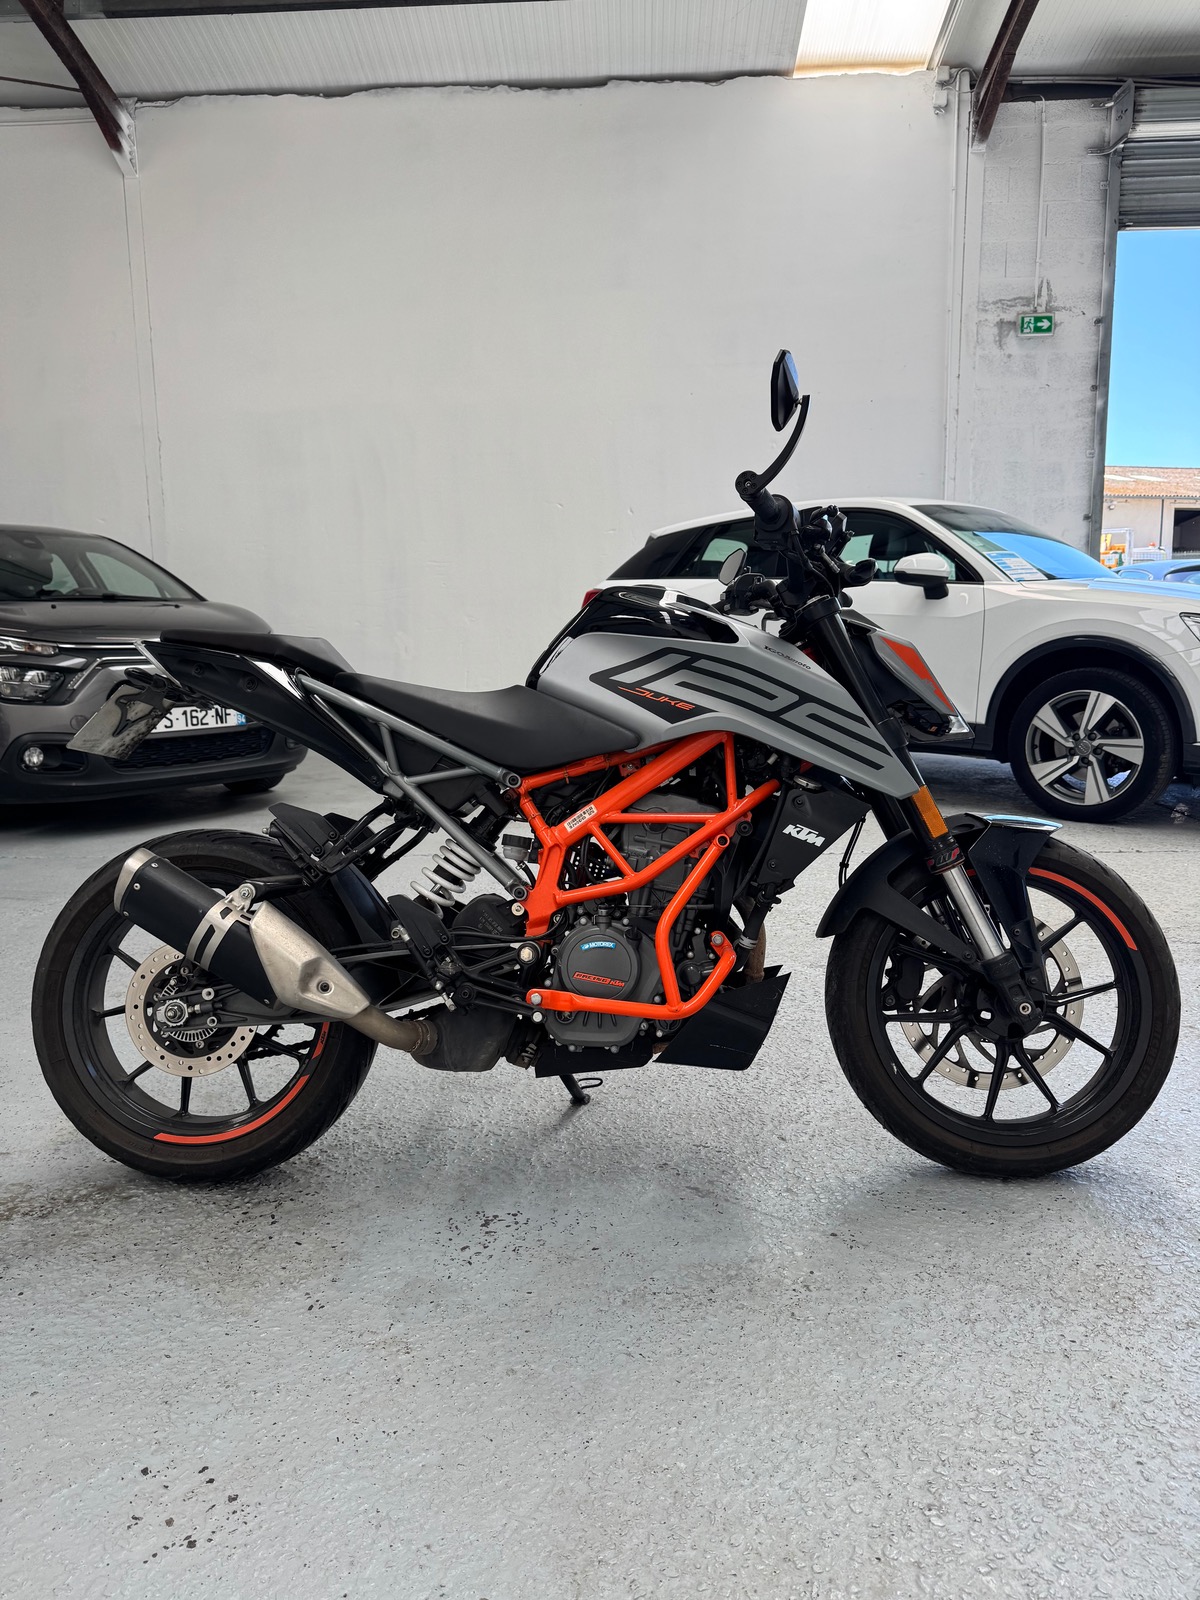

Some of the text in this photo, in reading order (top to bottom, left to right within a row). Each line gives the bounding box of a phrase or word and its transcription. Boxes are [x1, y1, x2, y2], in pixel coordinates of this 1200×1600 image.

[618, 686, 695, 711] DUKE
[155, 707, 231, 729] S-162-NF
[782, 824, 826, 847] KTM
[590, 941, 614, 949] MOTOREX
[575, 972, 609, 984] RACING
